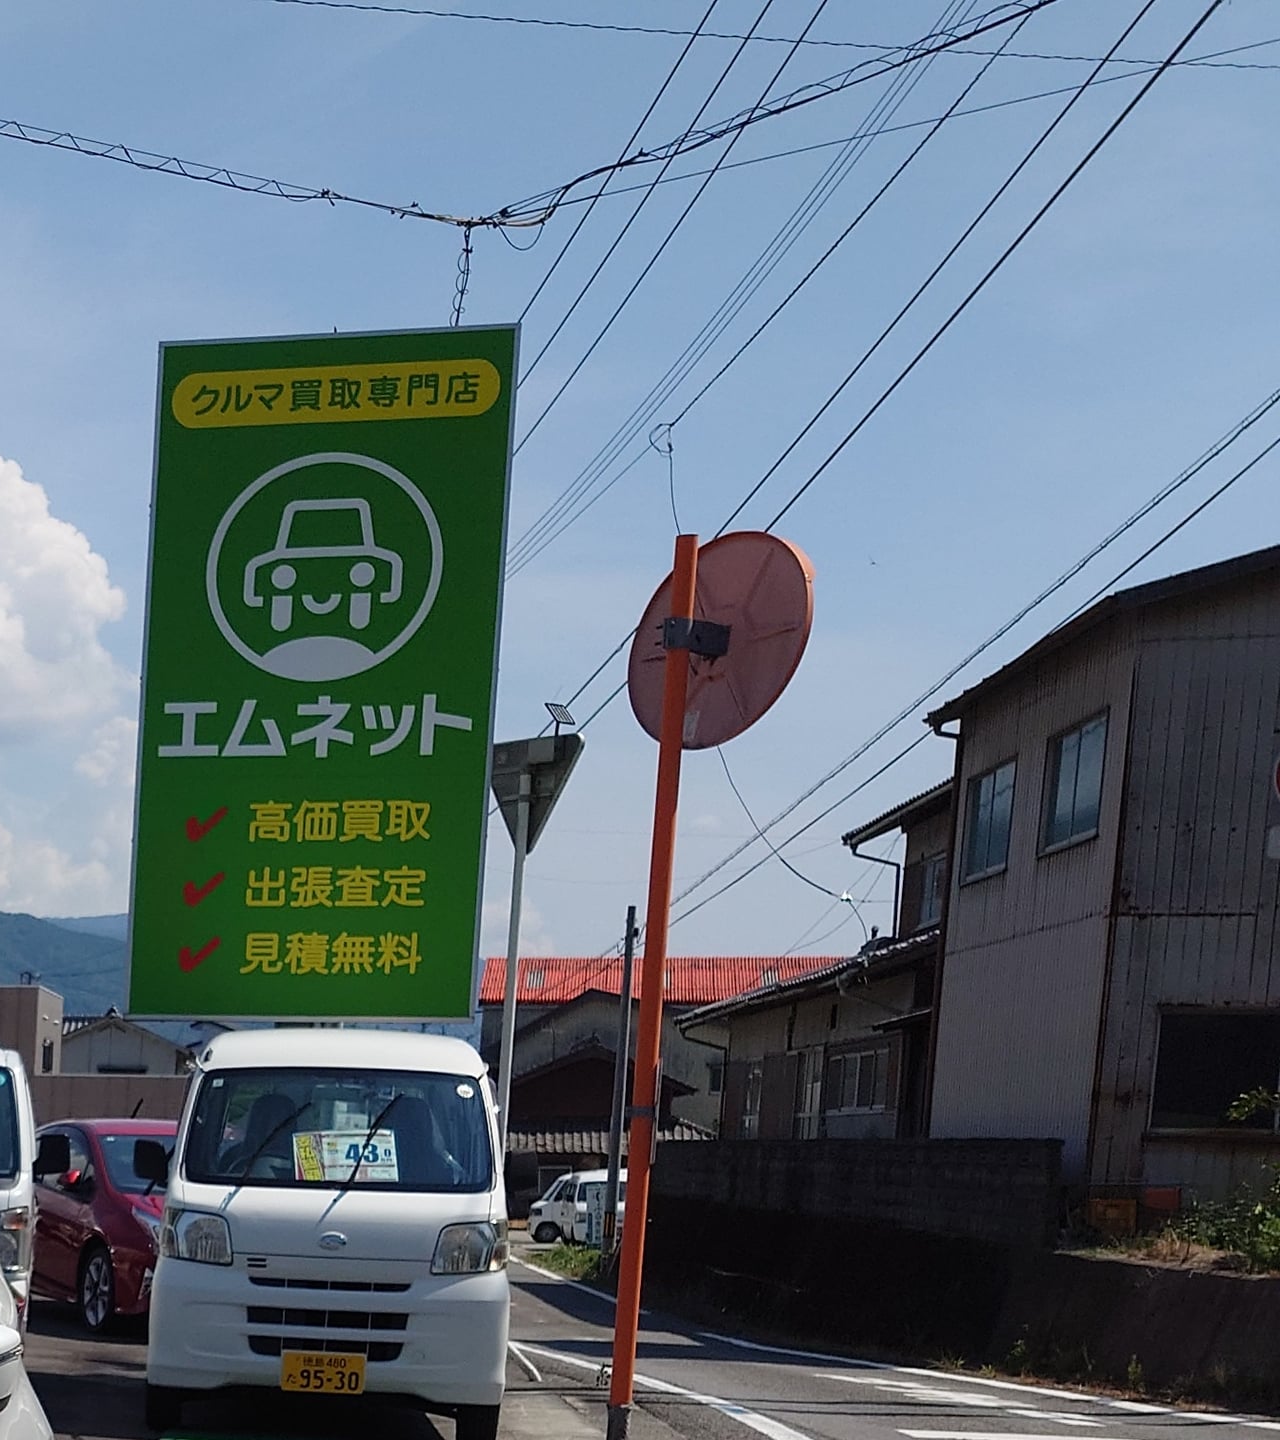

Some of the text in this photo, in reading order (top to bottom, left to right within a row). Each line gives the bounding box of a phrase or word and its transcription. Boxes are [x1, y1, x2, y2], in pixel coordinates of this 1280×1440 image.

[191, 371, 481, 416] クルマ買取専門店
[157, 693, 473, 759] エムネット
[247, 800, 431, 842] 高価買取
[244, 865, 427, 907] 出張査定
[239, 931, 422, 975] 見積無料
[300, 1369, 359, 1391] 95-30
